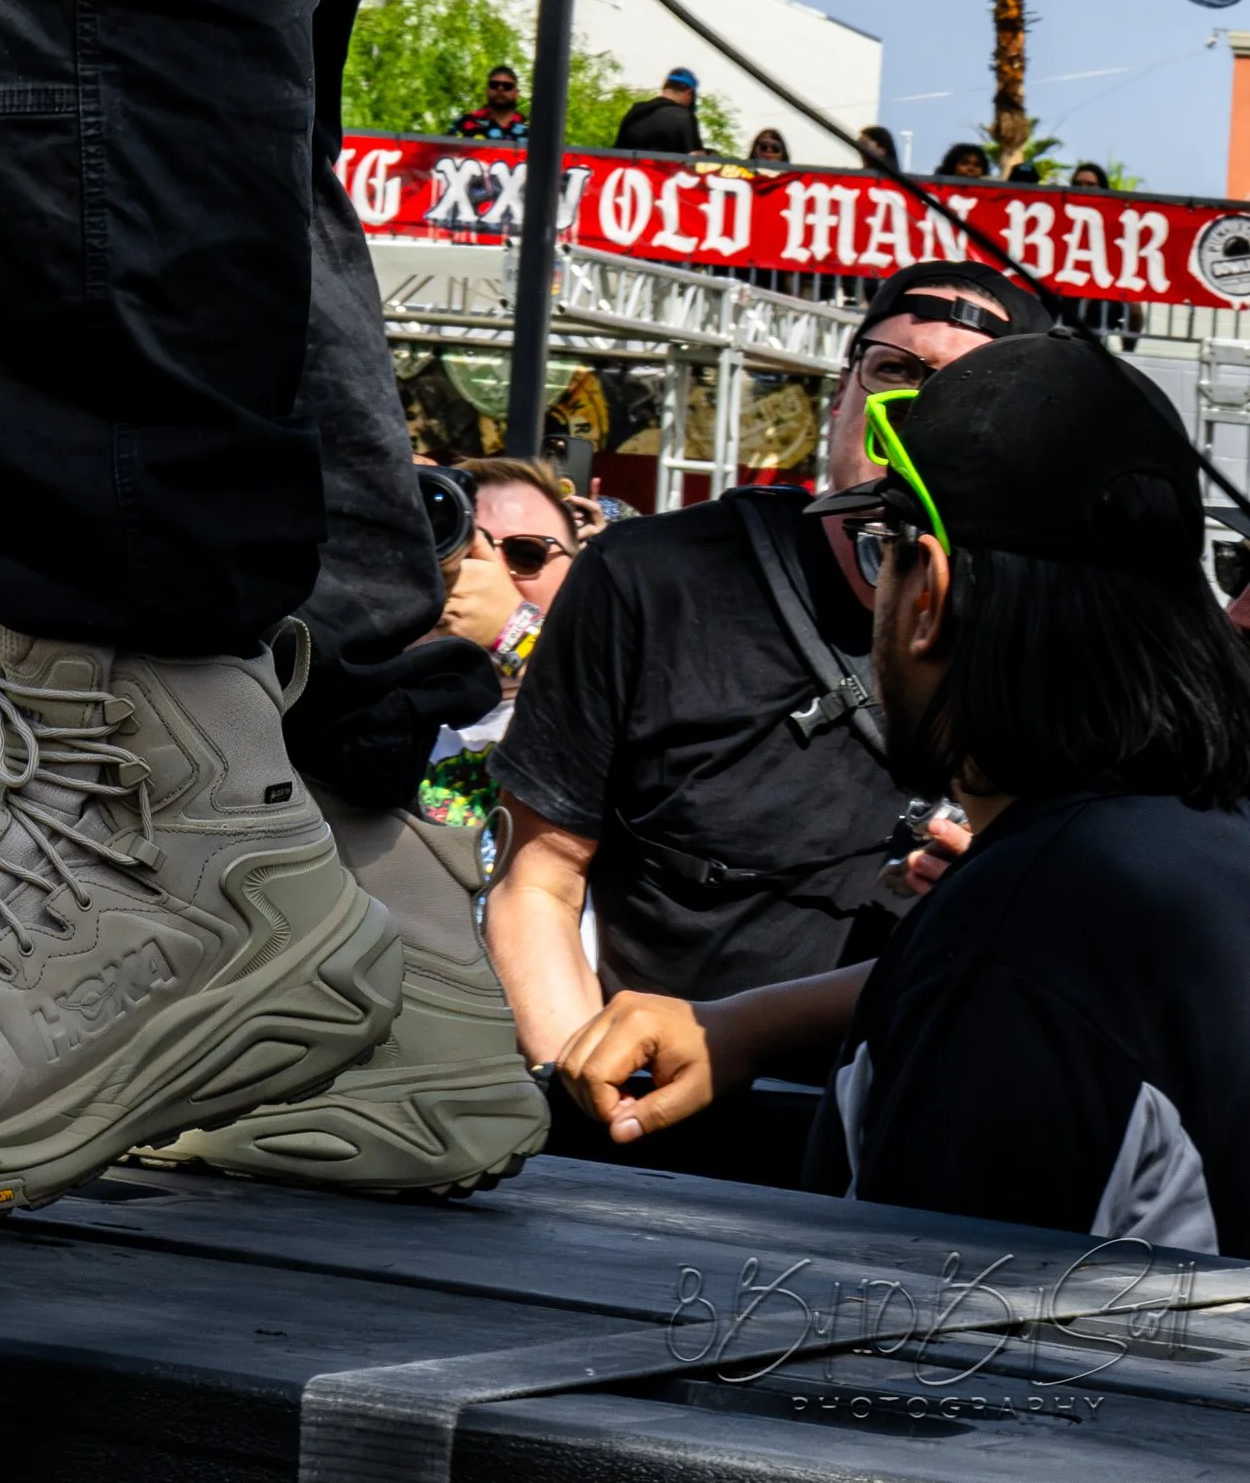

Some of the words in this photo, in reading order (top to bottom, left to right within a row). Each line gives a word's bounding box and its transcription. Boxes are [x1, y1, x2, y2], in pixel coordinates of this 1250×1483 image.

[599, 167, 751, 256] OLD
[780, 181, 978, 269] MAN
[1000, 199, 1171, 293] BAR
[31, 937, 177, 1064] HOKA
